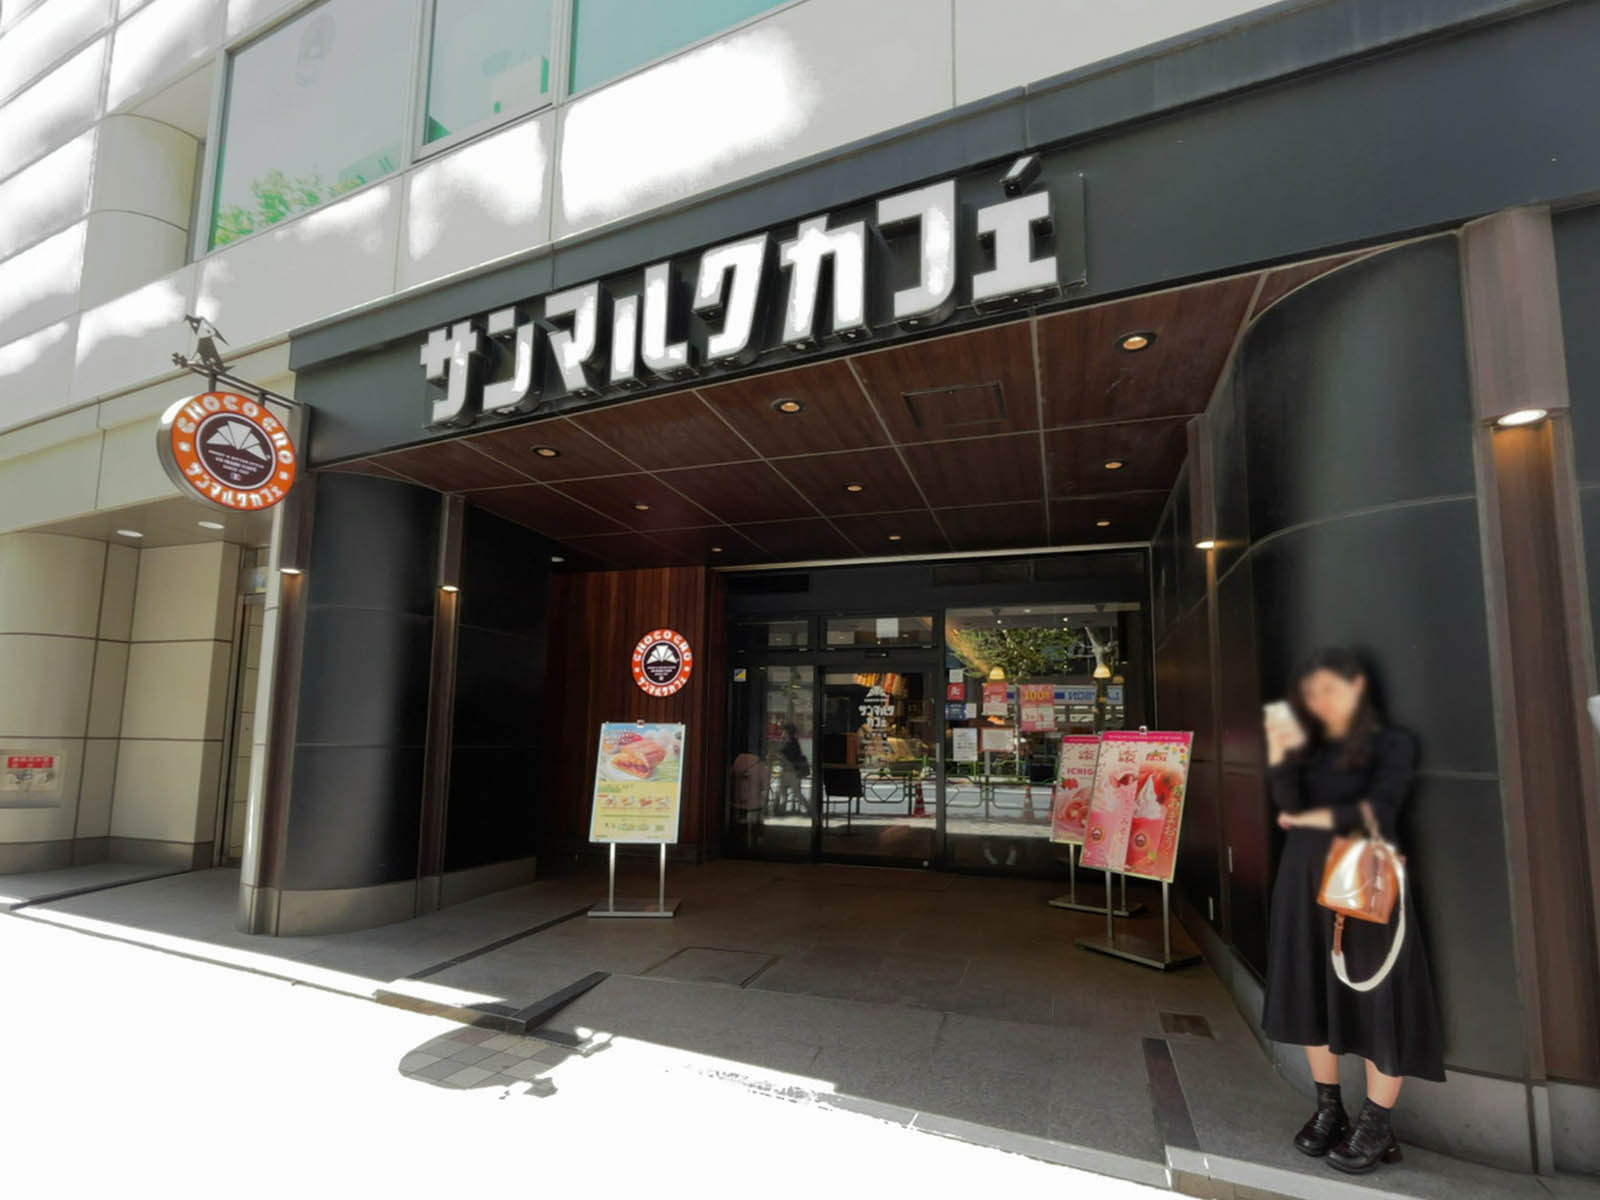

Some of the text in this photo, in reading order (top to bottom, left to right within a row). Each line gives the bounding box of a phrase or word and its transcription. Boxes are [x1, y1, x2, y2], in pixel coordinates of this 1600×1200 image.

[420, 156, 1059, 424] サンマルクカフェ
[177, 395, 259, 434] CHOCO
[186, 461, 283, 507] サンマルクカフェ
[633, 630, 673, 662] CHOCO
[637, 676, 688, 697] サンマルクカフェ
